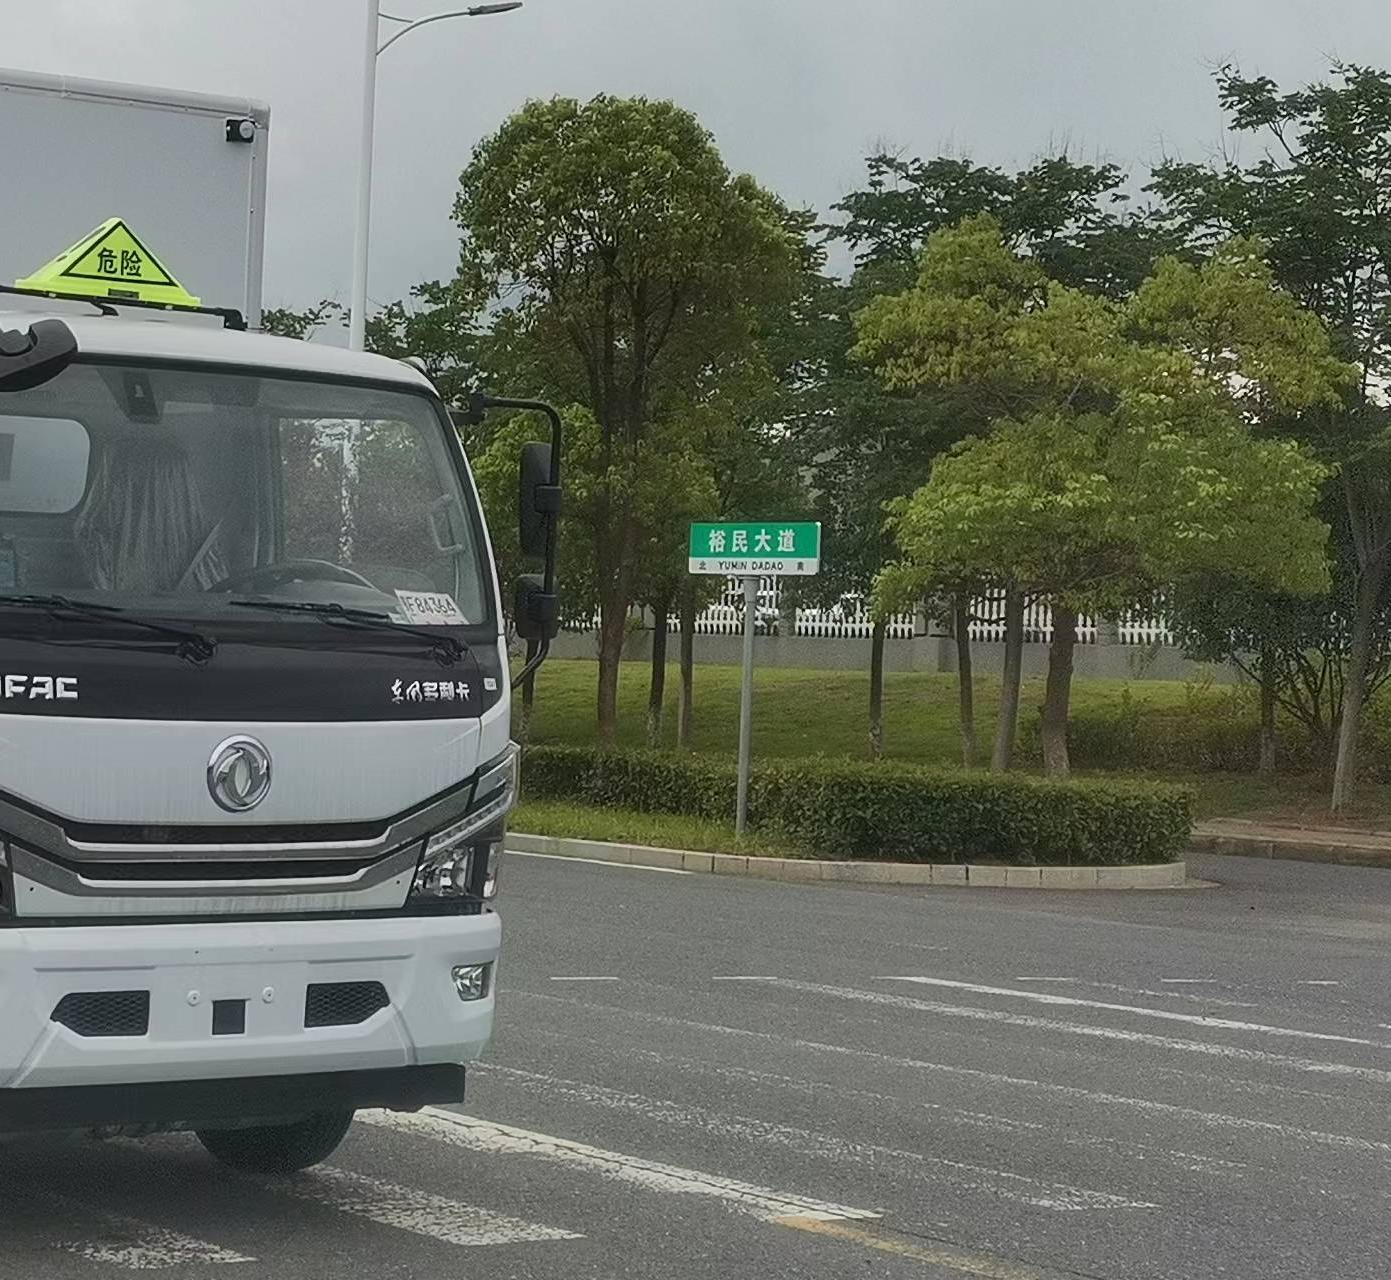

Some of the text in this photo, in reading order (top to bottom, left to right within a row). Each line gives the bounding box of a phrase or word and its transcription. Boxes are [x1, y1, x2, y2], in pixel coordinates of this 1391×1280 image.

[96, 247, 143, 277] 危险
[708, 528, 796, 553] 裕民大道
[718, 561, 784, 571] YUMIN DADAO
